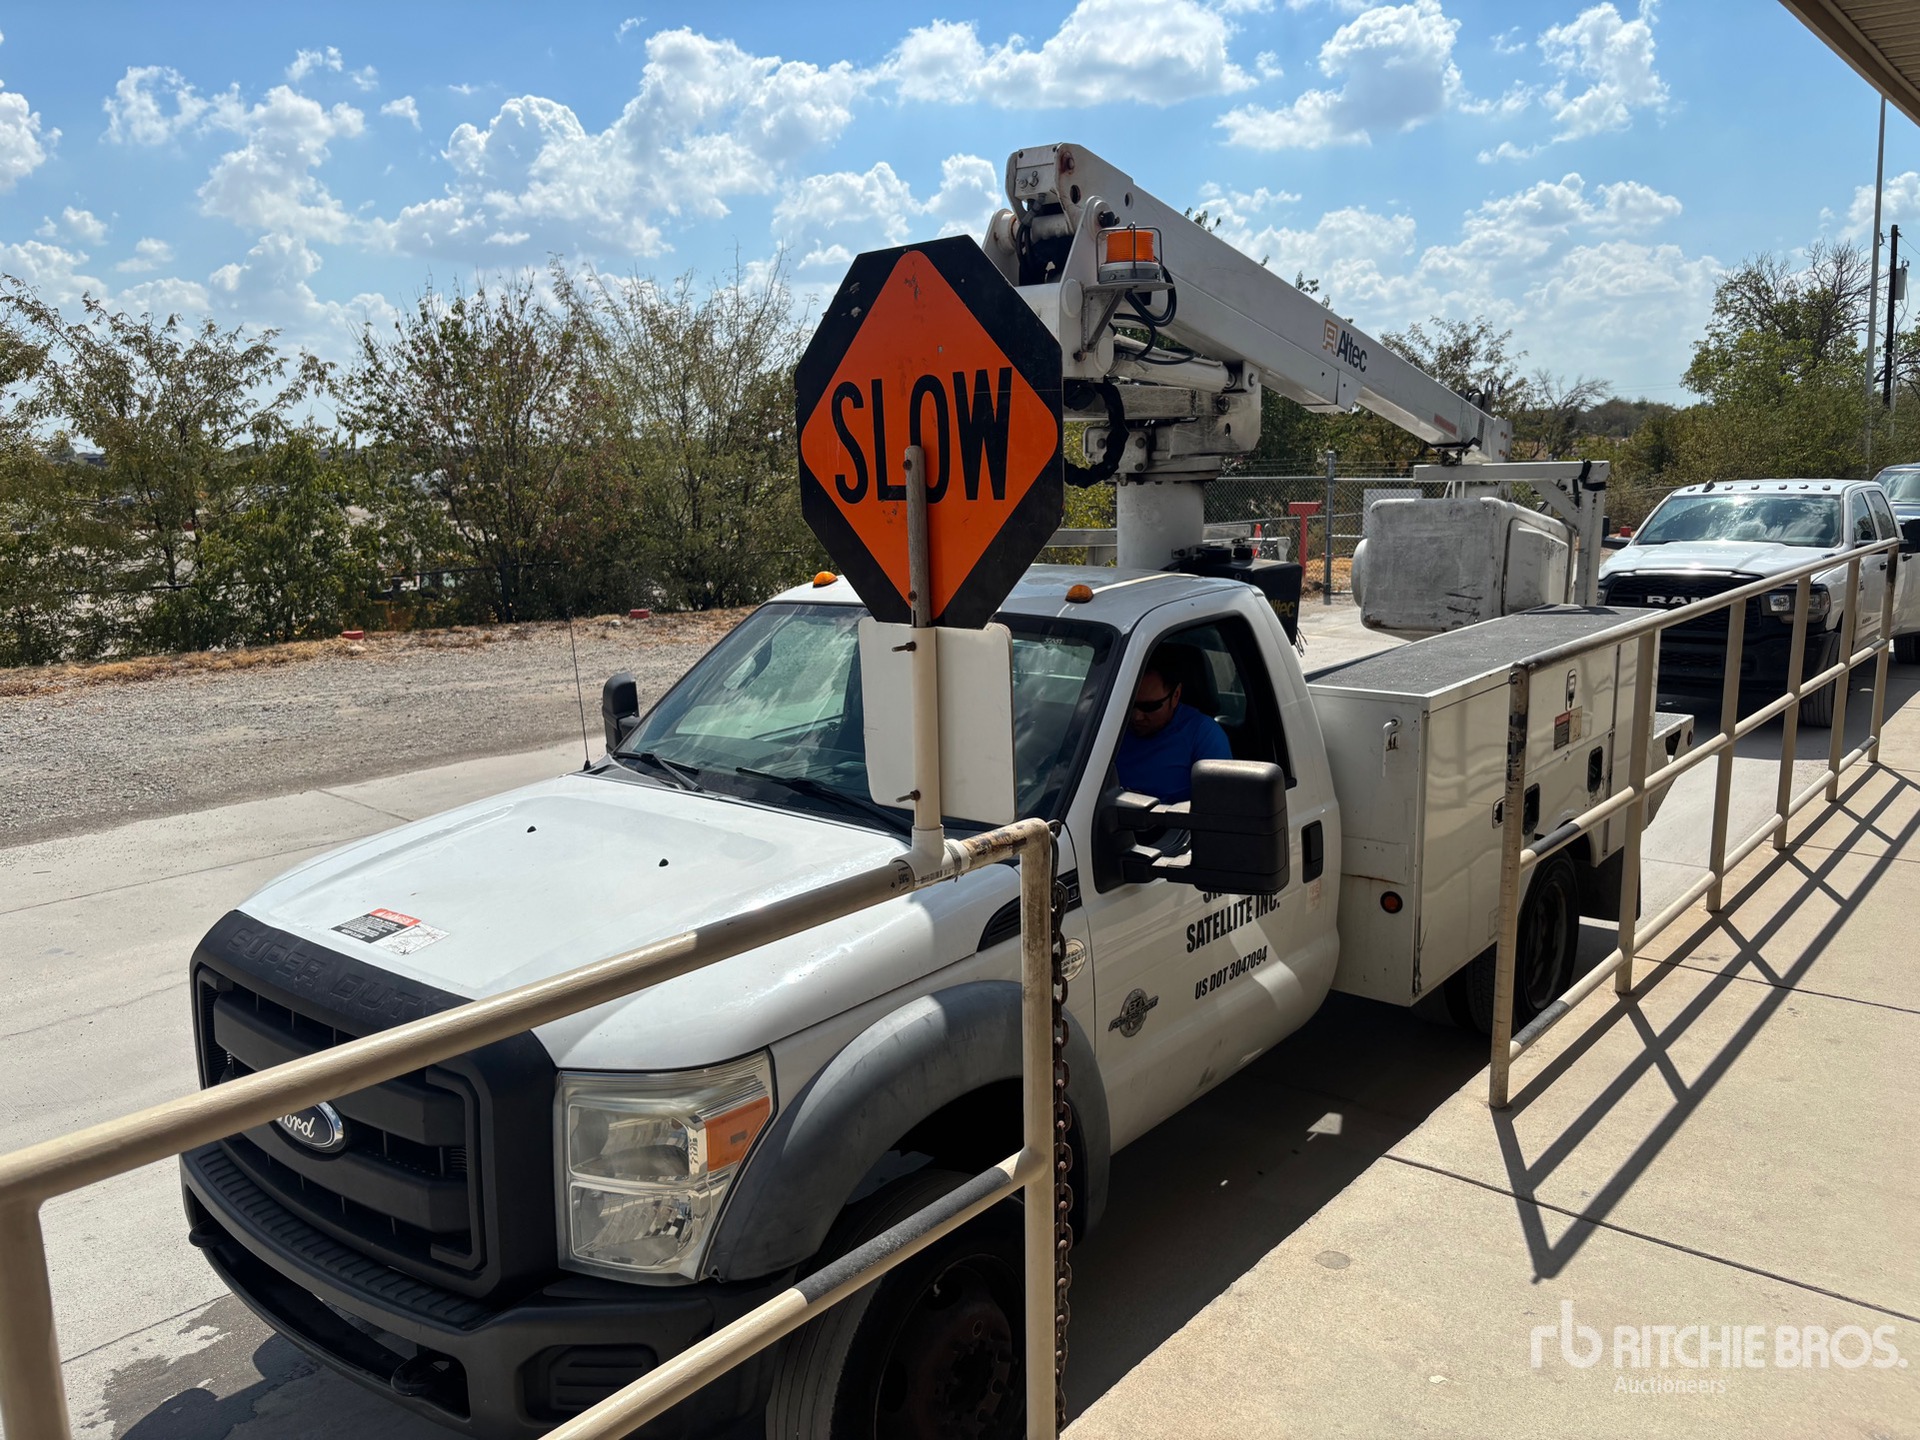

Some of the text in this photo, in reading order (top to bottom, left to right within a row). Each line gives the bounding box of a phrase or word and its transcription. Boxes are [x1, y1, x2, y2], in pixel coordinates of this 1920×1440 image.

[1336, 330, 1368, 373] Altec
[831, 367, 1012, 503] SLOW
[1186, 894, 1280, 953] SATELLITE INC.
[225, 927, 327, 987] SUPER
[1194, 945, 1268, 1000] US DOT 3047094
[282, 1113, 316, 1138] ord
